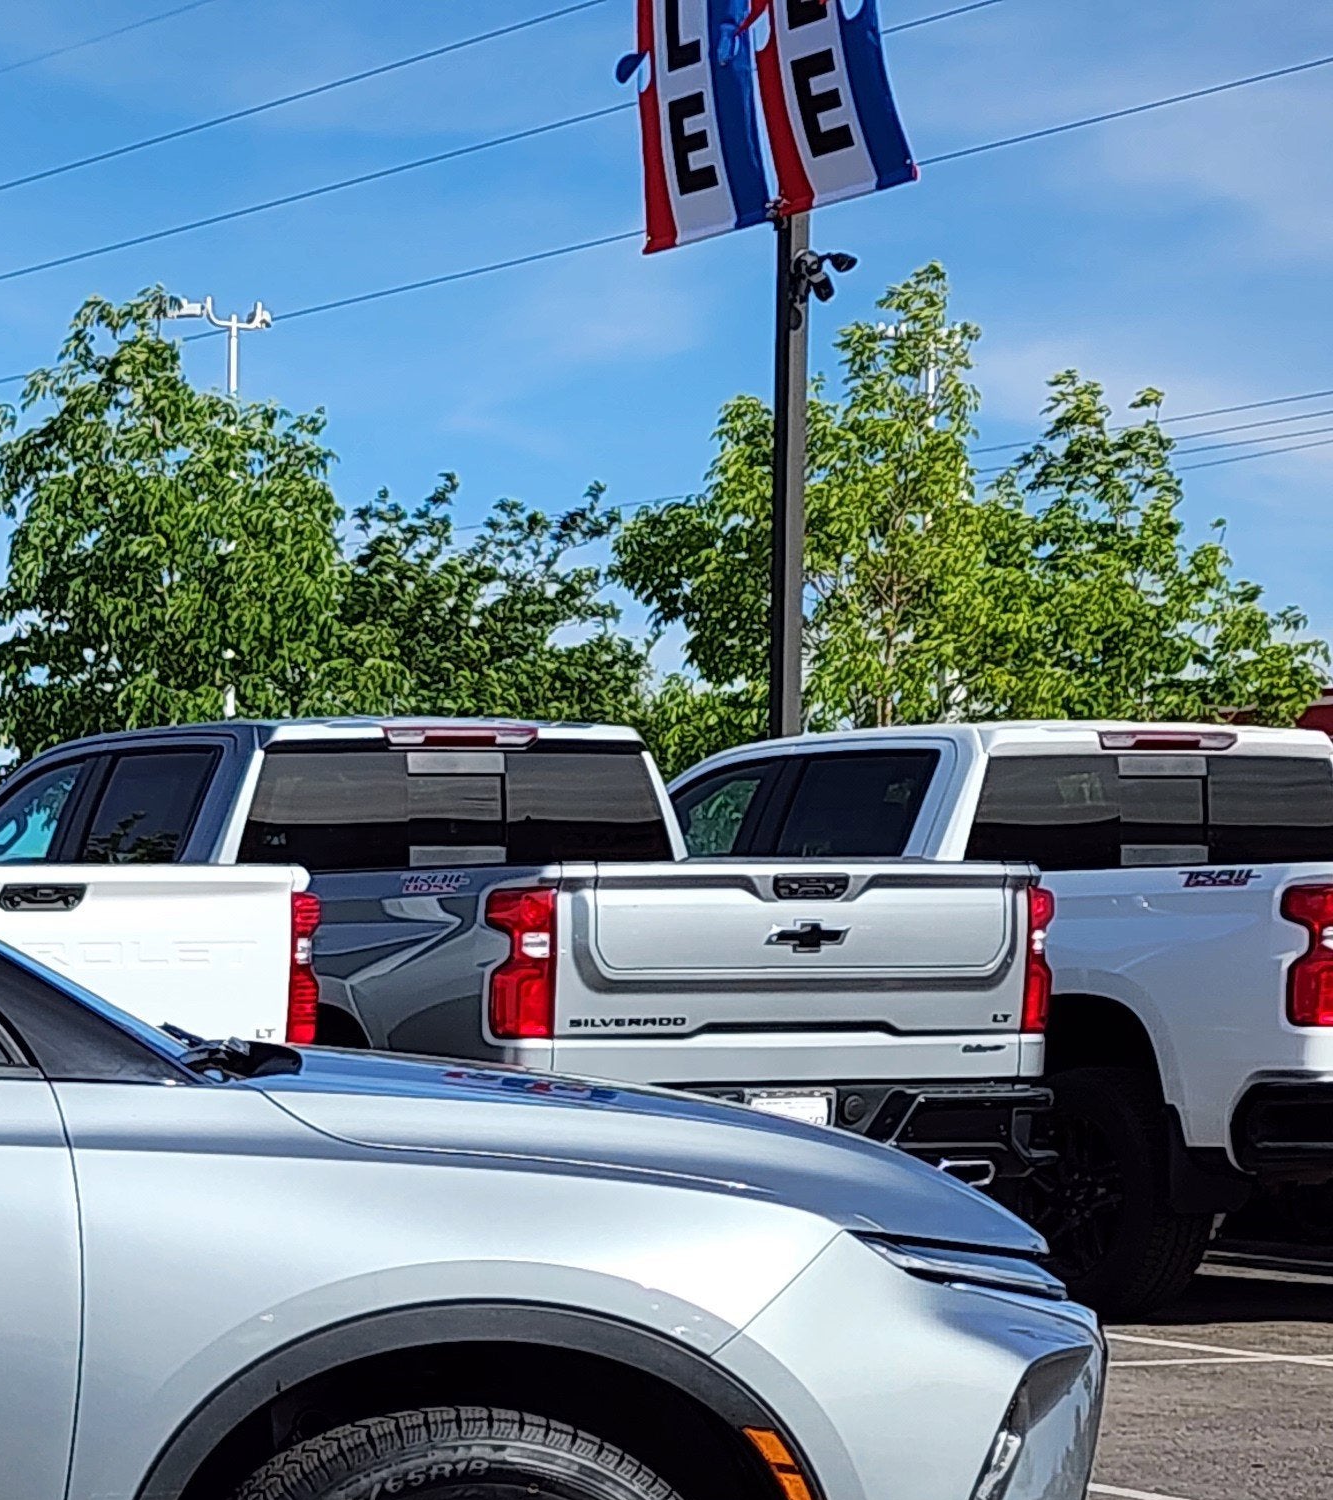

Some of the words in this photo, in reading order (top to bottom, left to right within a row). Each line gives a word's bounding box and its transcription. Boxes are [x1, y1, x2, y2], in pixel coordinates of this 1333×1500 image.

[569, 1017, 687, 1028] SILVERADO
[991, 1013, 1012, 1023] LT
[255, 1028, 276, 1039] LT
